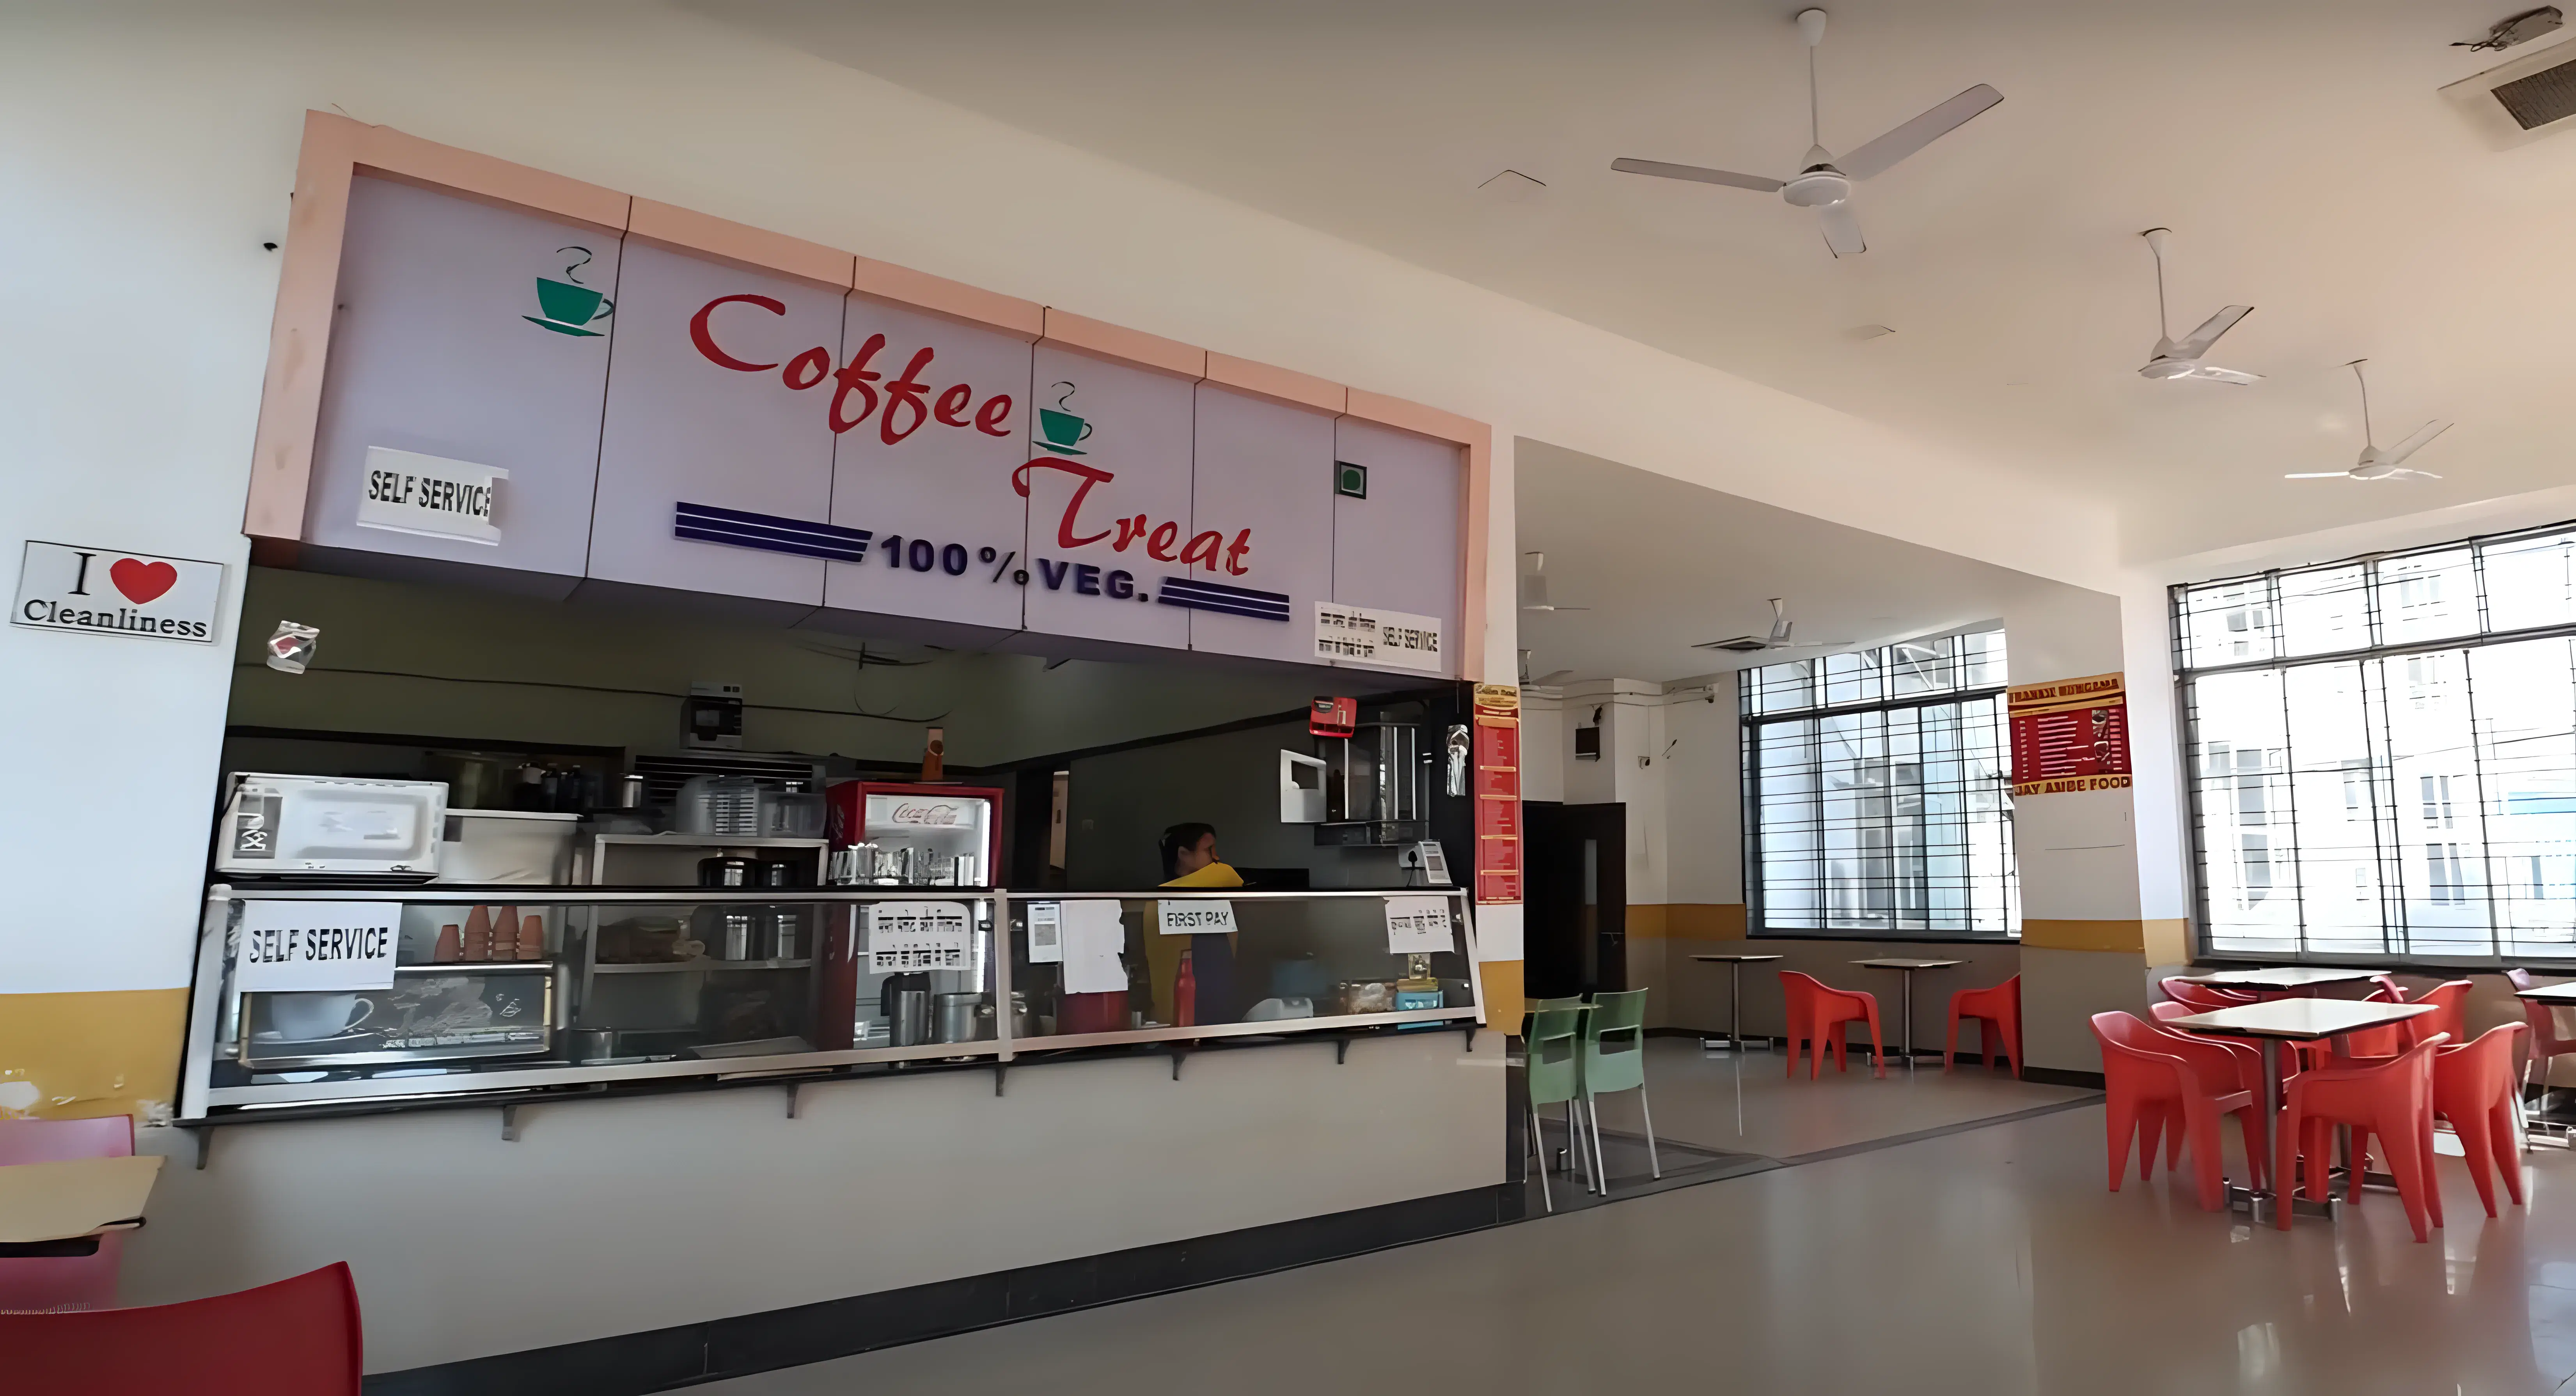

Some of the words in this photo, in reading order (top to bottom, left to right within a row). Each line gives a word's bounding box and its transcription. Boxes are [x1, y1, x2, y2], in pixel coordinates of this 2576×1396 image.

[689, 294, 1012, 445] Coffee
[368, 470, 417, 503] SELF
[1011, 457, 1251, 576] Treat
[67, 551, 97, 595] I
[1038, 558, 1148, 602] VEG.
[24, 599, 207, 638] Cleanliness
[2090, 776, 2131, 791] FOOD
[1167, 912, 1201, 927] FIRST
[1206, 911, 1228, 925] PAY
[250, 929, 300, 964] SELF
[305, 927, 388, 960] SERVICE
